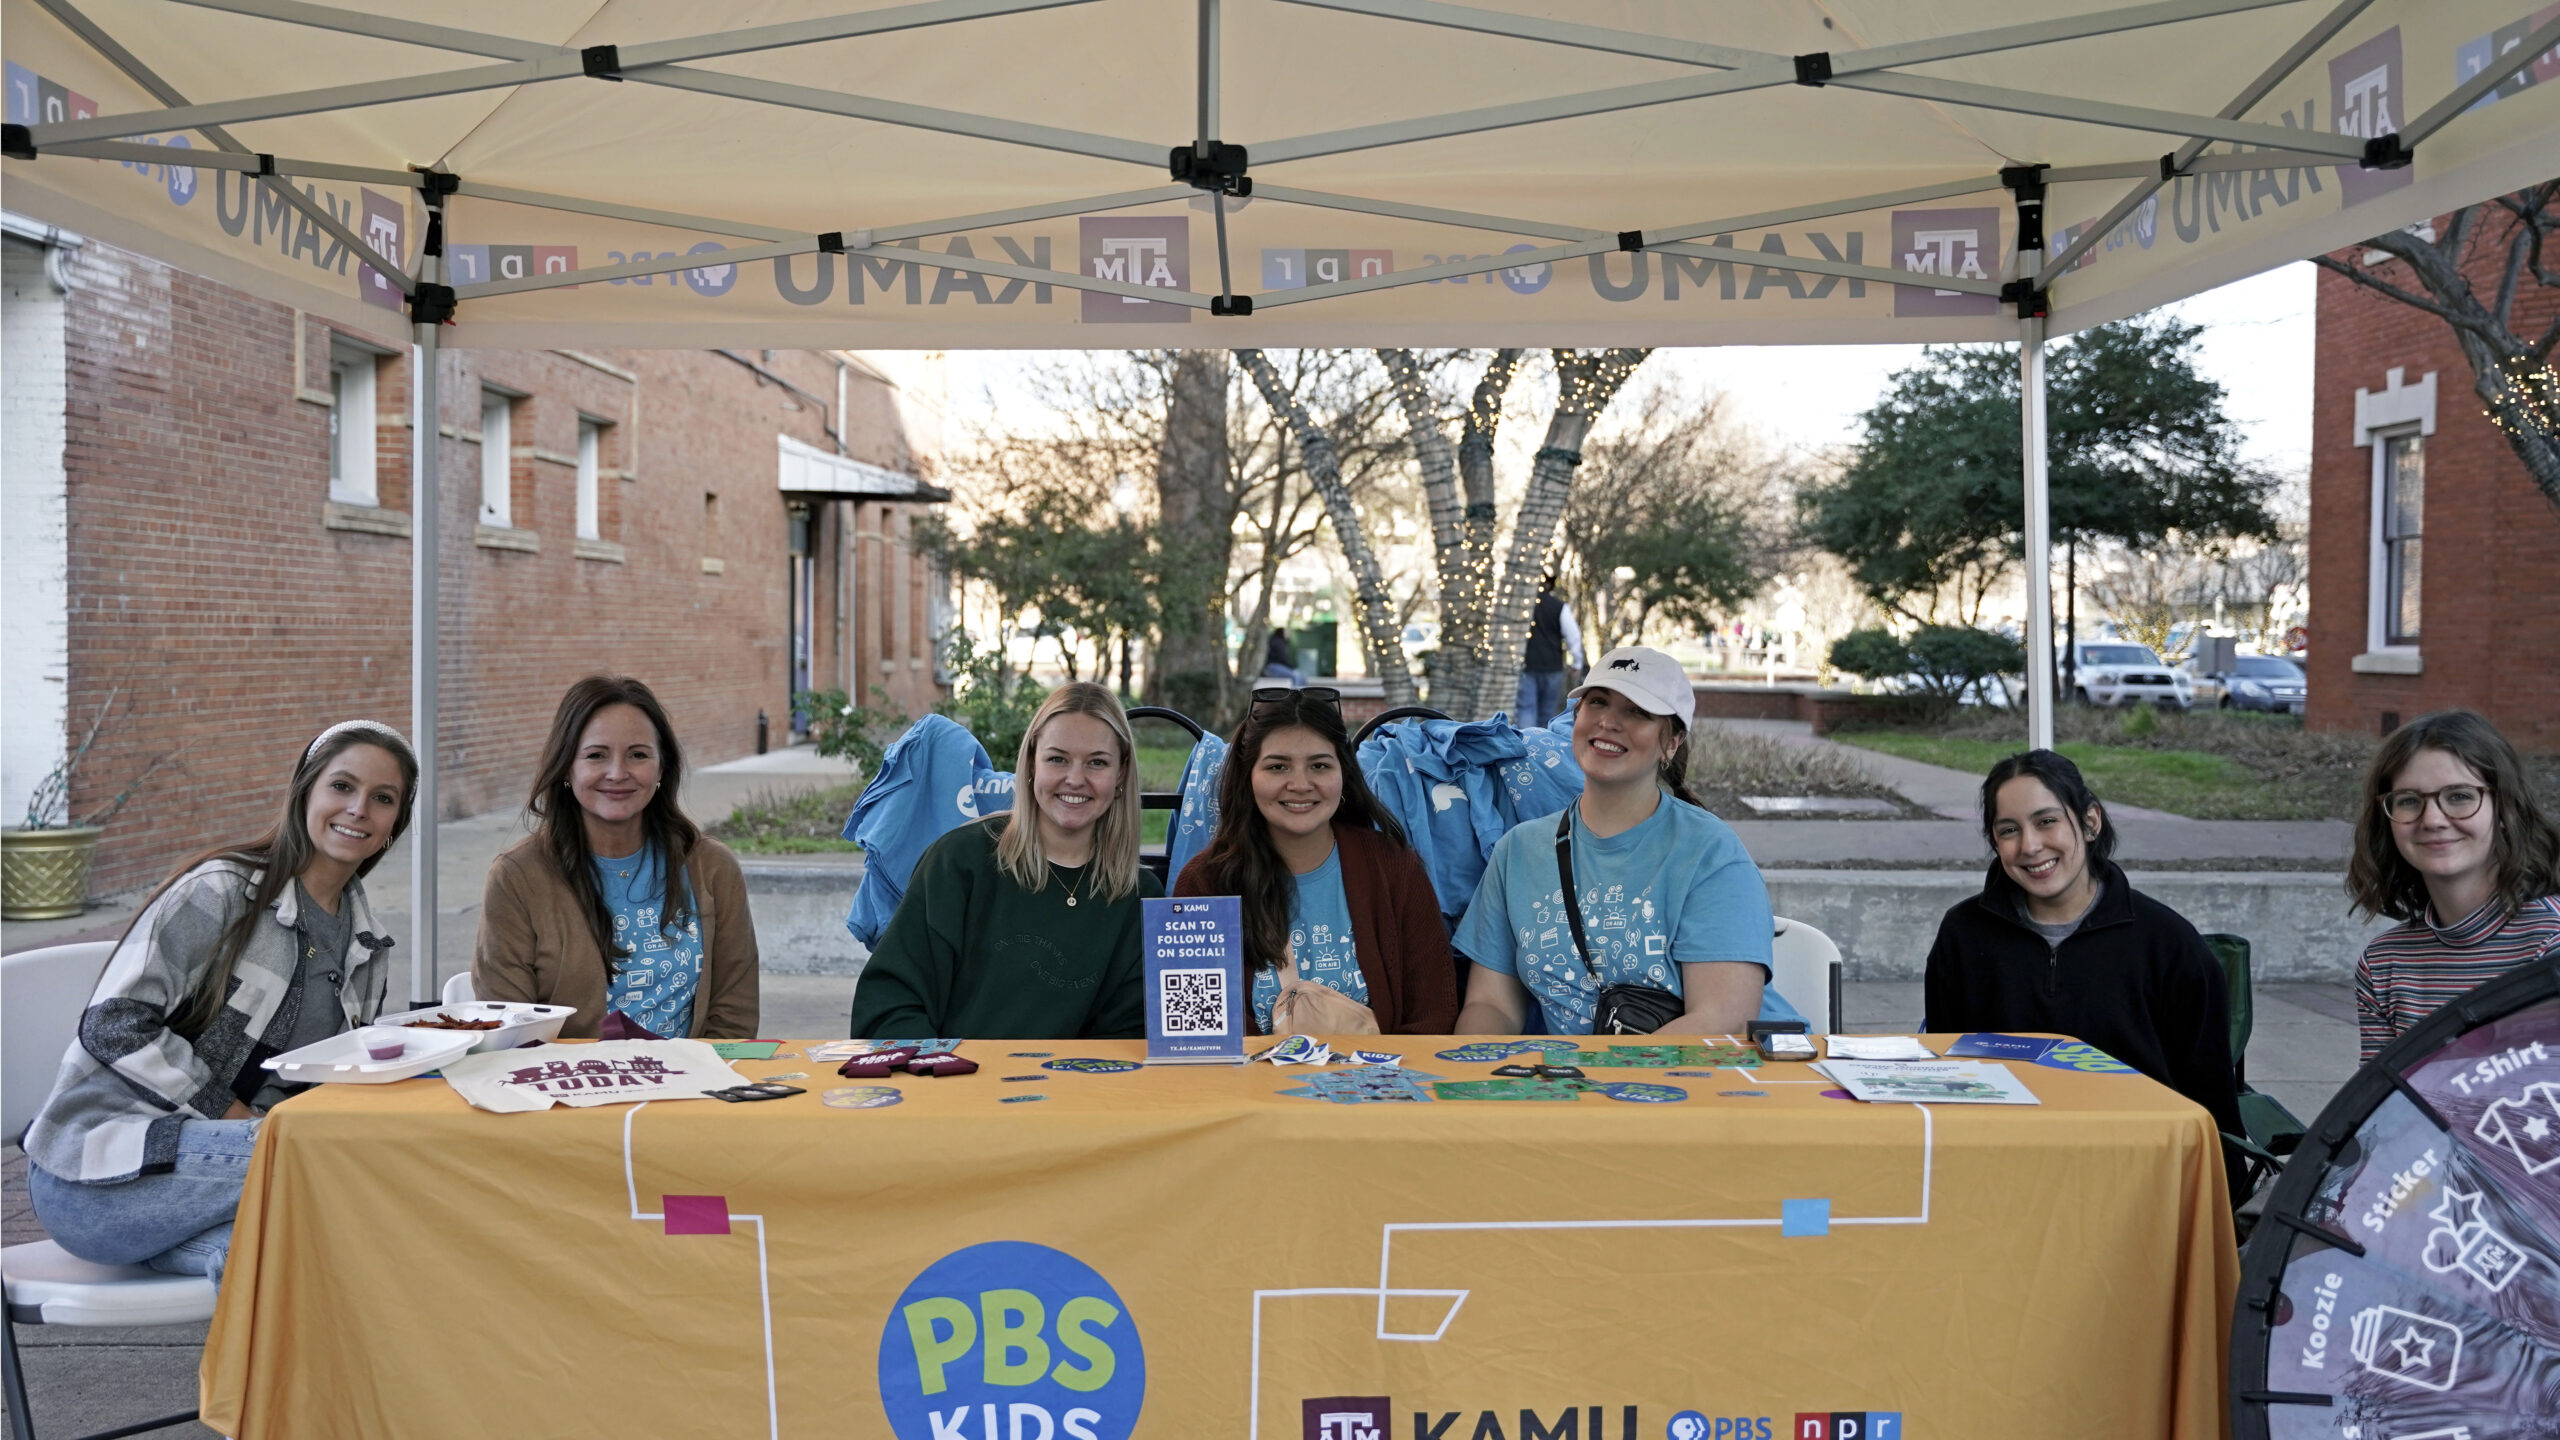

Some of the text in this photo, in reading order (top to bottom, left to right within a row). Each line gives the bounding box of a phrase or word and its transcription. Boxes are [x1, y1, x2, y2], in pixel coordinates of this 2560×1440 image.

[1184, 904, 1209, 912] KAMU
[1165, 920, 1216, 930] SCAN TO
[1157, 933, 1225, 944] FOLLOW US
[1157, 948, 1225, 958] ON SOCIAL!
[1362, 1052, 1393, 1060] KIDS
[2450, 1040, 2549, 1096] T-Shirt
[528, 1075, 664, 1091] TODAY
[2362, 1147, 2439, 1234] Sticker
[2302, 1271, 2344, 1369] Koozie
[903, 1288, 1120, 1396] PBS
[1715, 1416, 1772, 1440] PBS
[1803, 1418, 1891, 1440] npr
